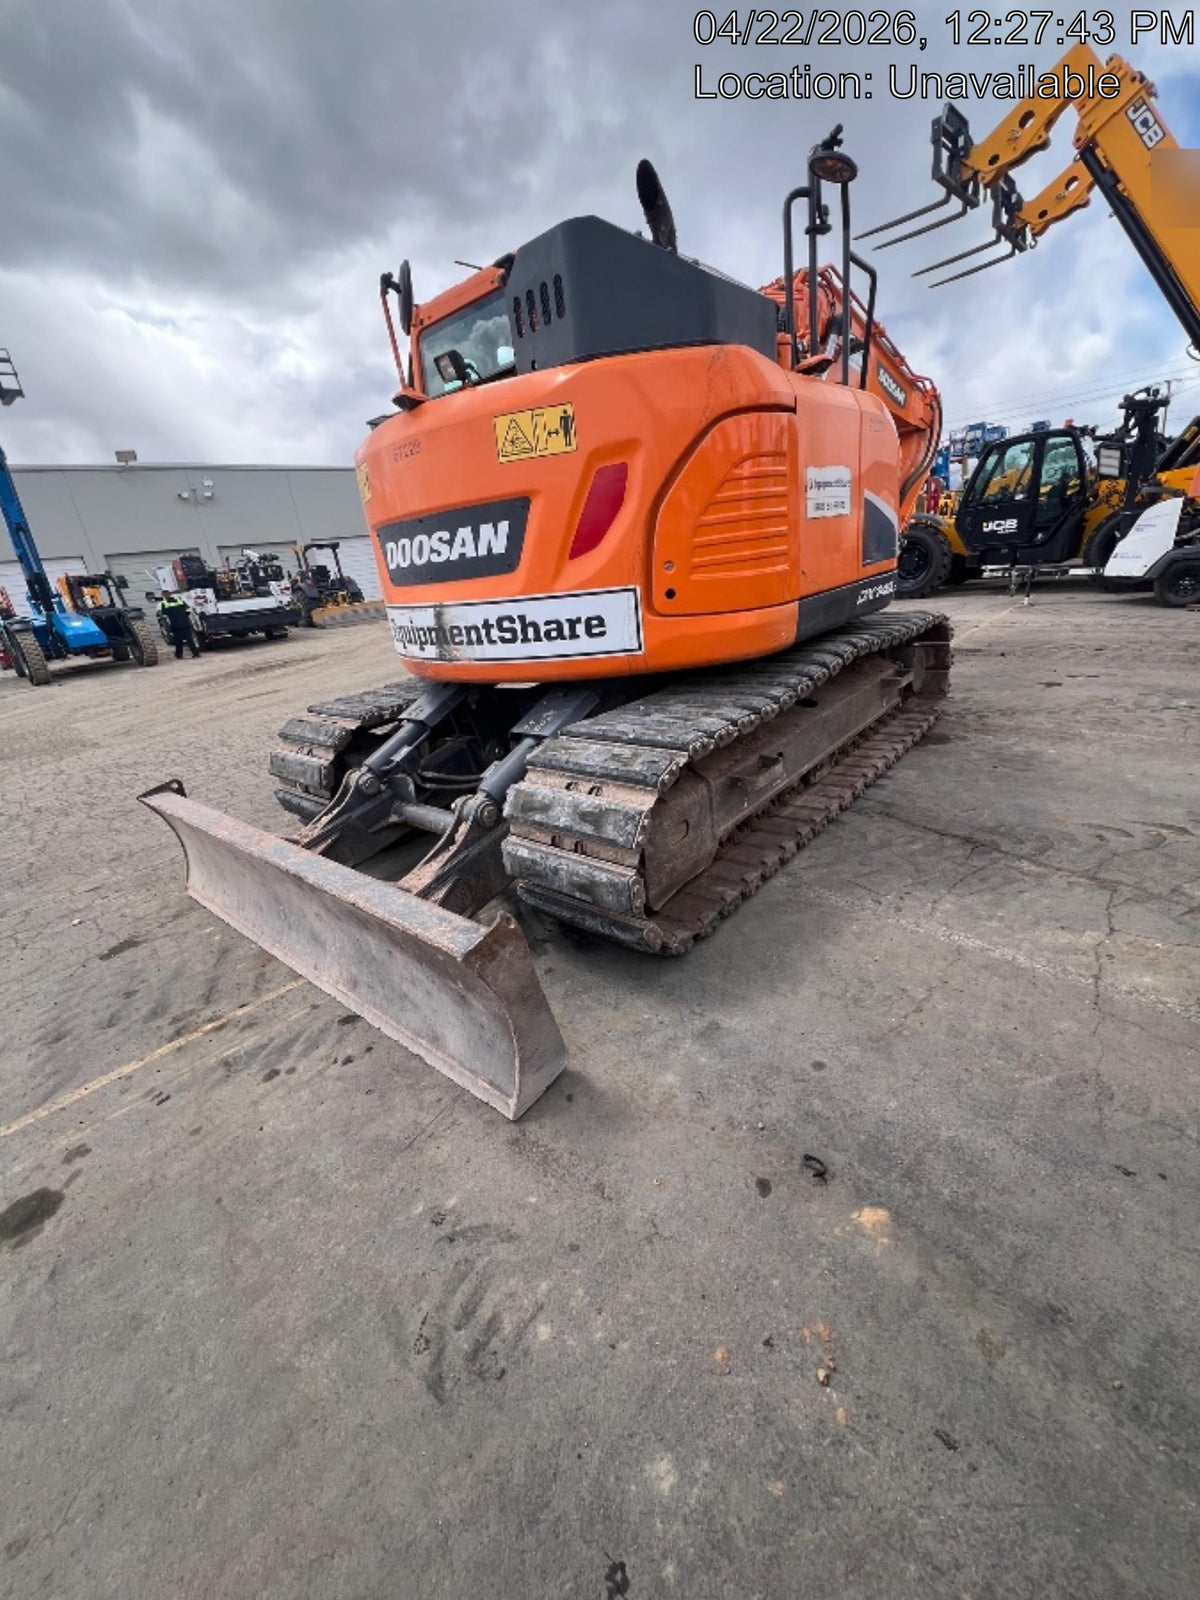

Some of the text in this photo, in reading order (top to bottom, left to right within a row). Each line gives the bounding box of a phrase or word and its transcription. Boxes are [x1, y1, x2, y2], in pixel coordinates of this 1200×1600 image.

[1126, 100, 1165, 149] JCB
[385, 520, 510, 570] DOOSAN
[982, 518, 1018, 532] JCB
